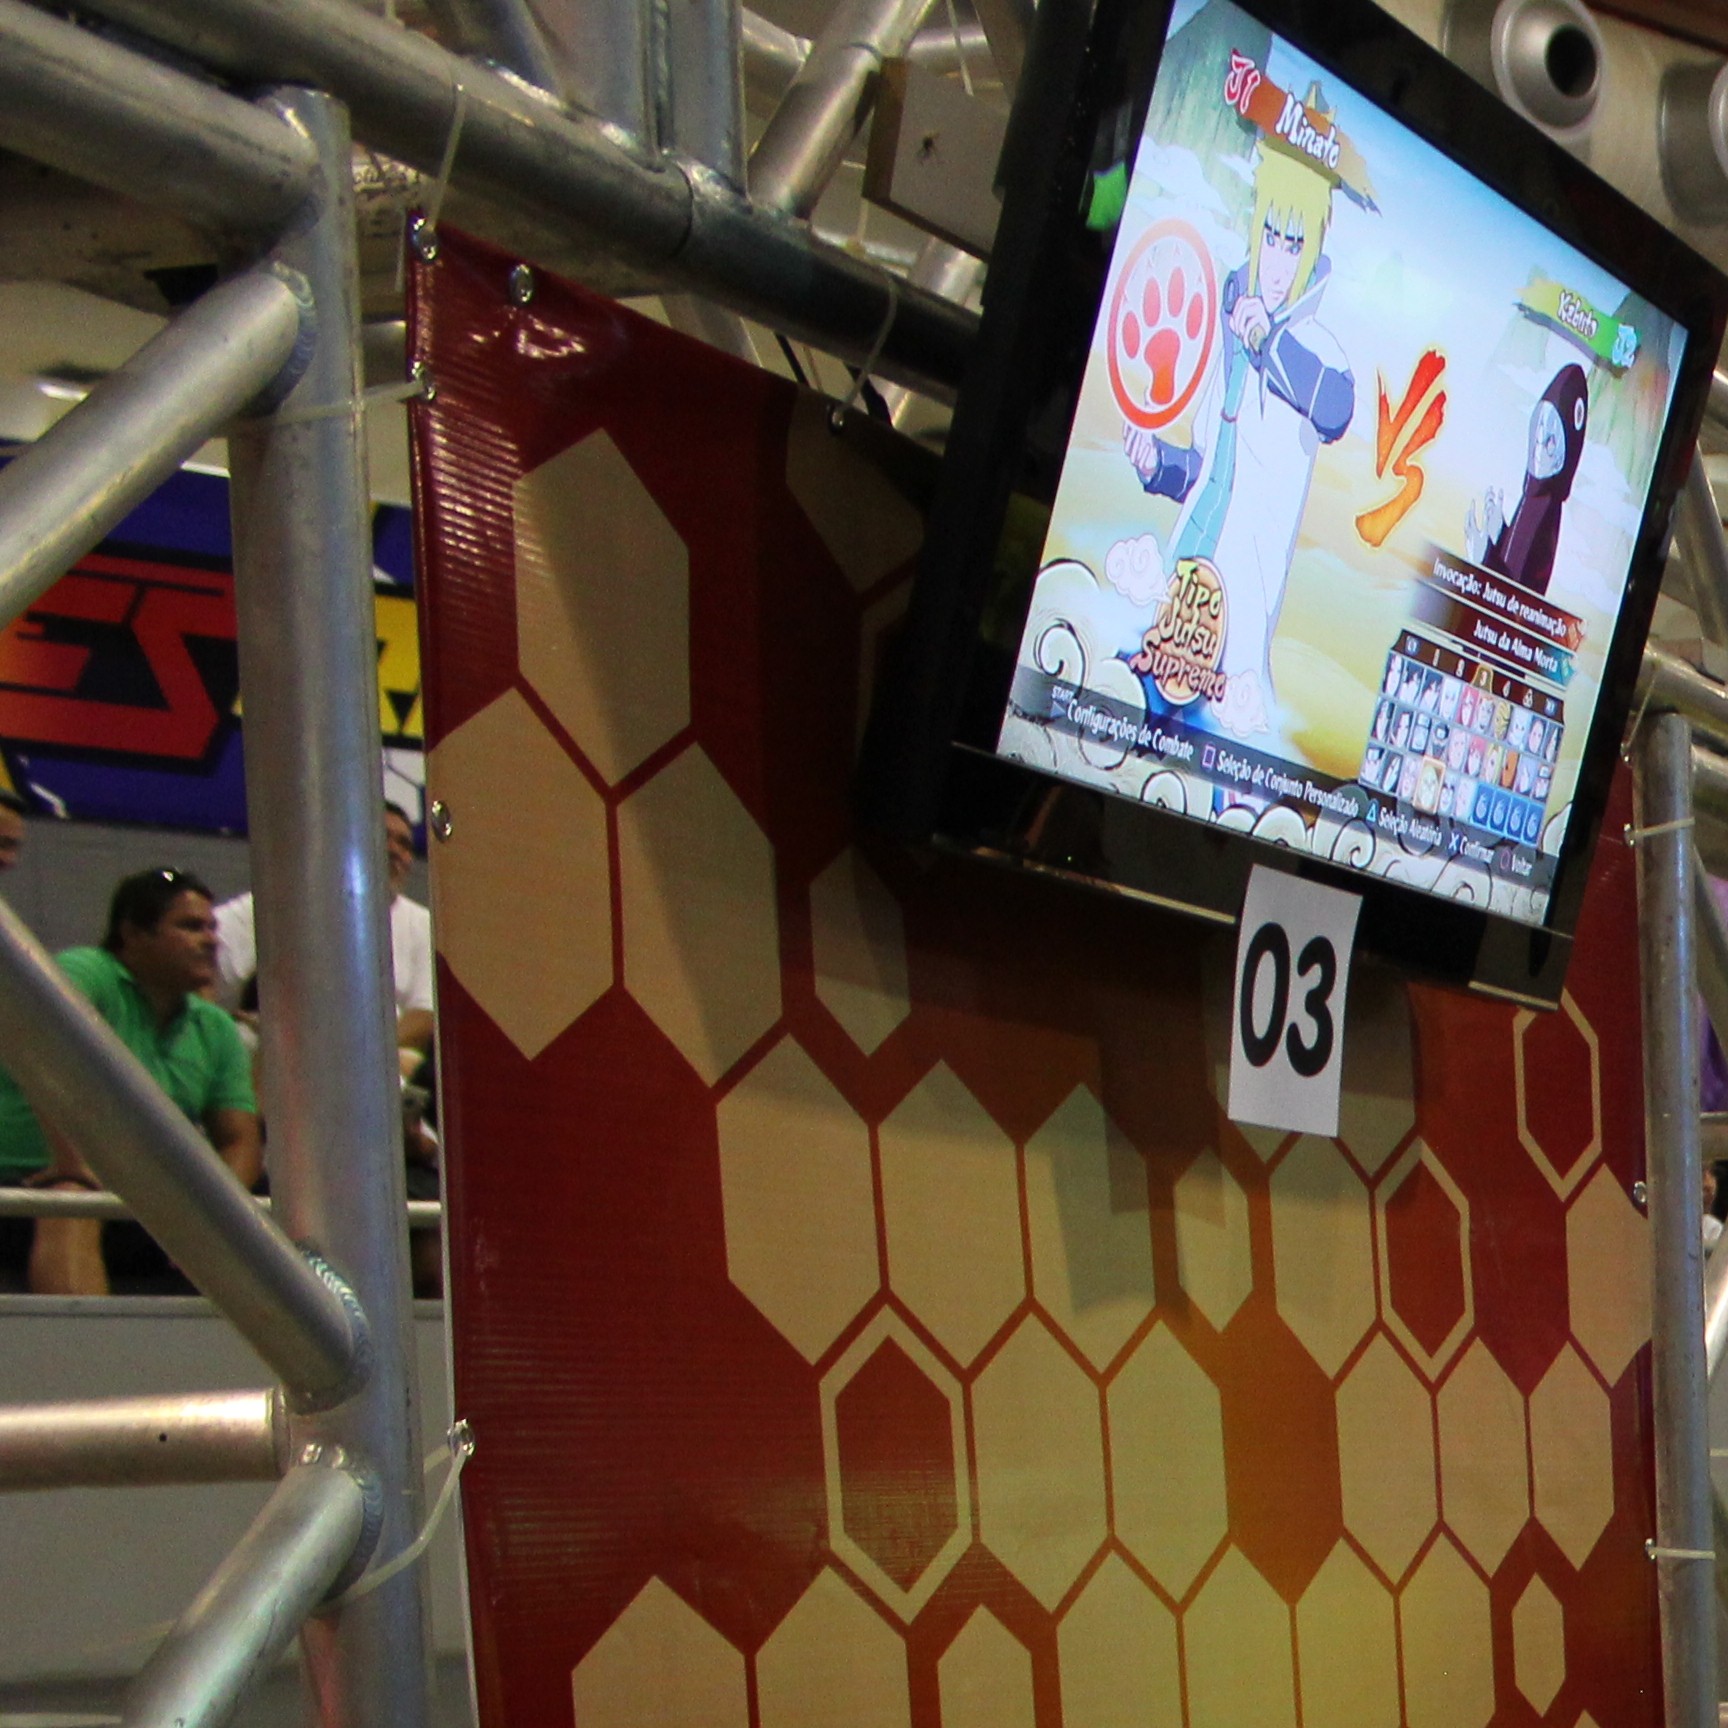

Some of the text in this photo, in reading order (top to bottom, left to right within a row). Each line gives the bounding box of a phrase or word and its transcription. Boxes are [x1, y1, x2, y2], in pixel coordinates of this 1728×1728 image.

[1275, 92, 1340, 169] Minato
[1355, 349, 1447, 548] VS
[1176, 560, 1222, 617] Tipo
[1507, 595, 1520, 613] de
[1159, 597, 1218, 659] Jutsu
[1130, 631, 1227, 702] Supremo
[1067, 700, 1137, 745] Configurações
[1139, 725, 1151, 747] de
[1152, 728, 1194, 761] Combate
[1216, 751, 1251, 783] Seleção
[1251, 763, 1264, 785] de
[1240, 921, 1337, 1078] 03
